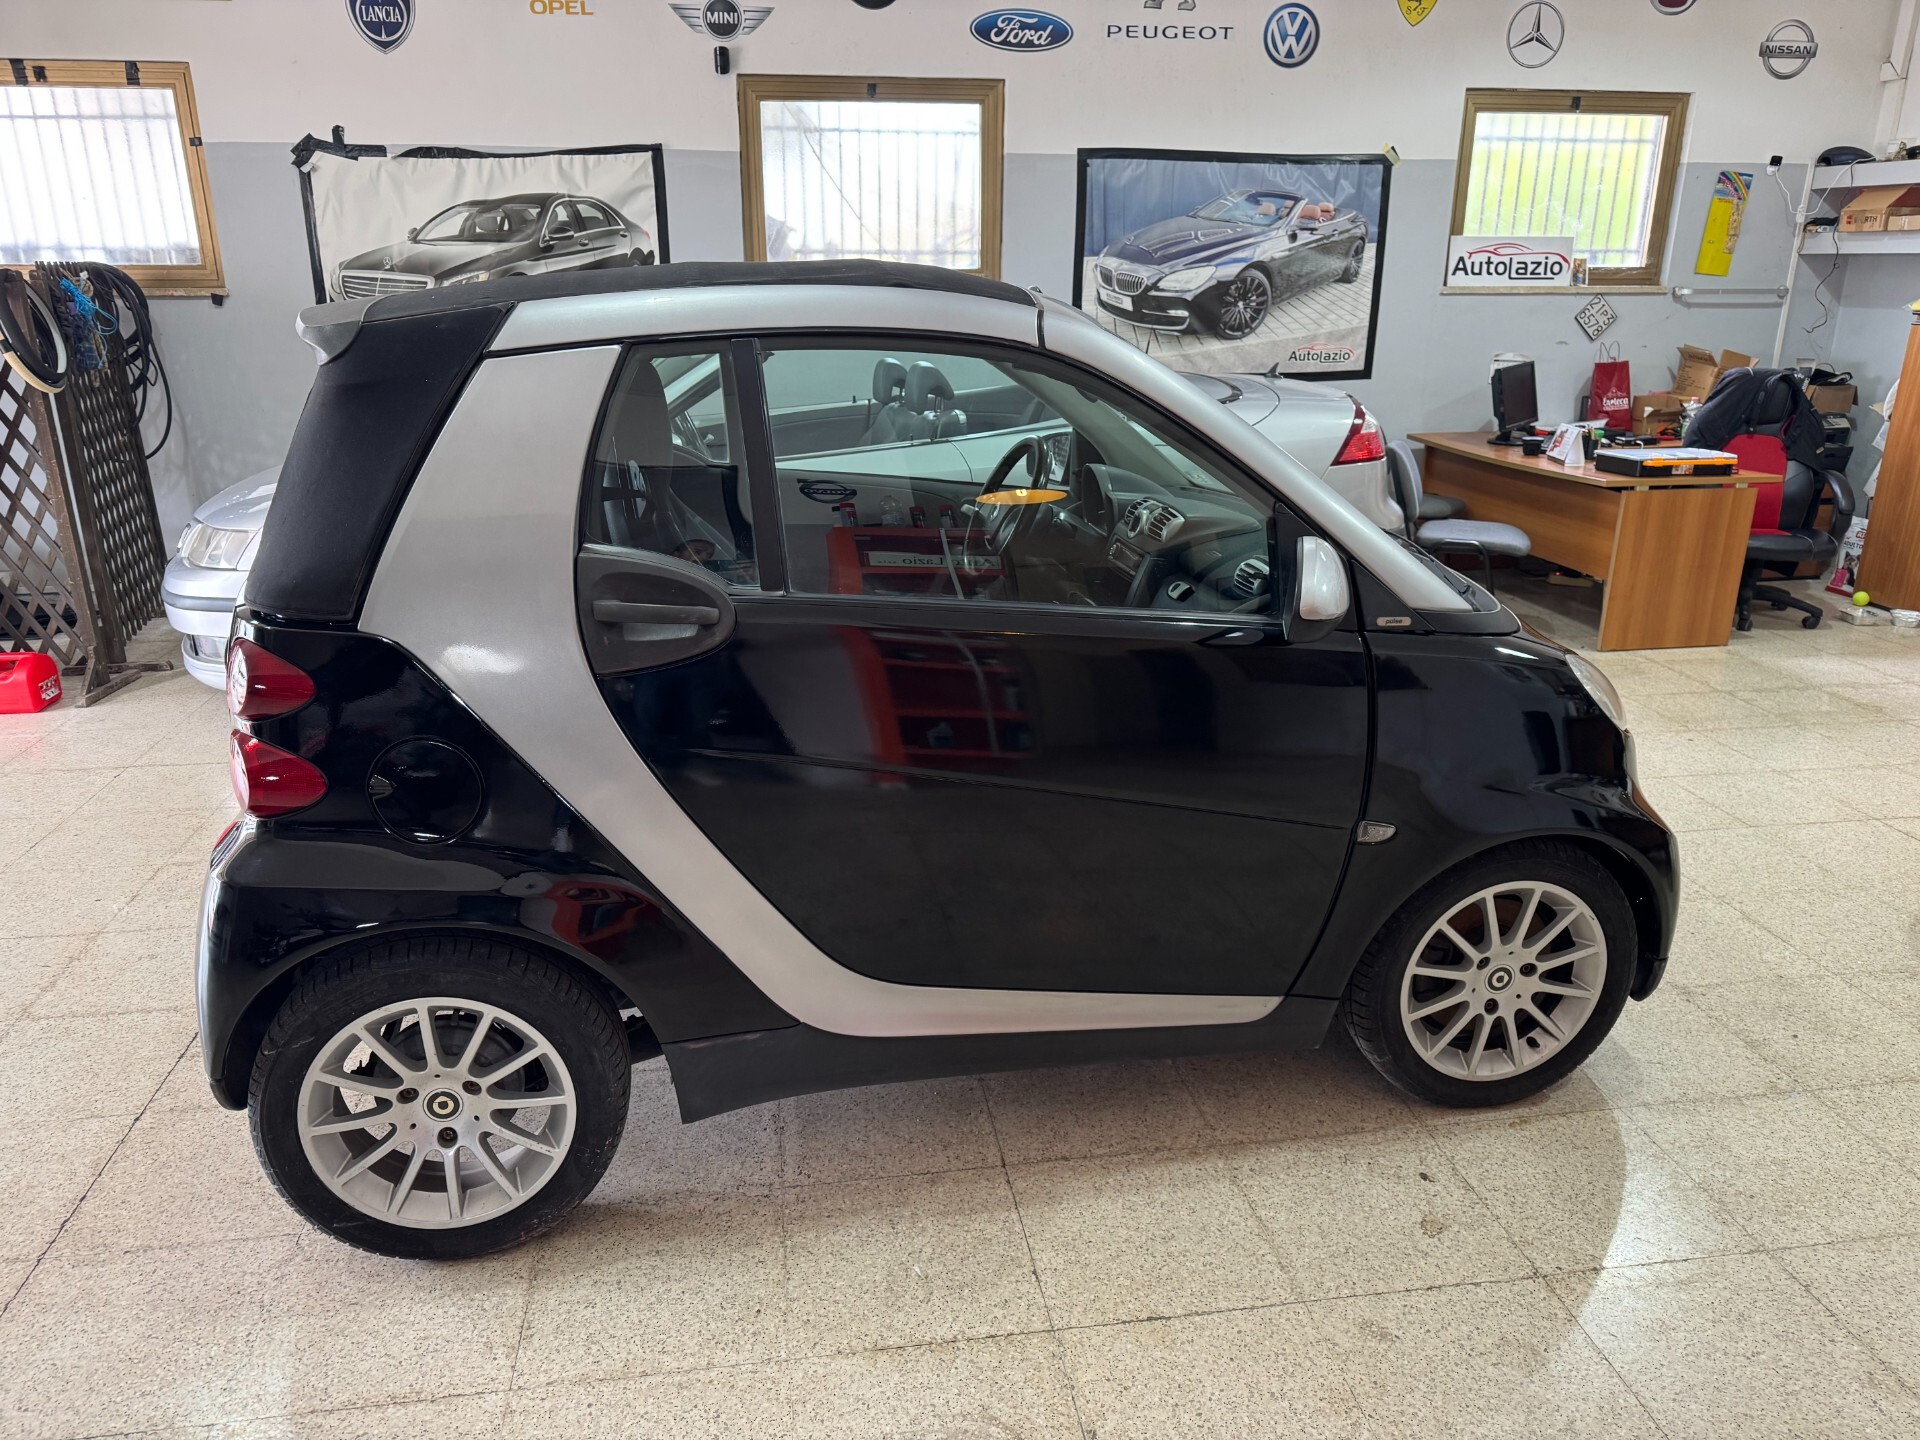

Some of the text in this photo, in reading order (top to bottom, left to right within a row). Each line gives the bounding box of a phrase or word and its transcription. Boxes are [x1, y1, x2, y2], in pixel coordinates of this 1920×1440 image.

[361, 5, 402, 22] LANCIA
[529, 0, 594, 15] OPEL
[706, 11, 738, 24] MINI
[990, 15, 1053, 45] Ford
[1106, 24, 1234, 40] PEUGEOT
[1764, 45, 1812, 54] NISSAN
